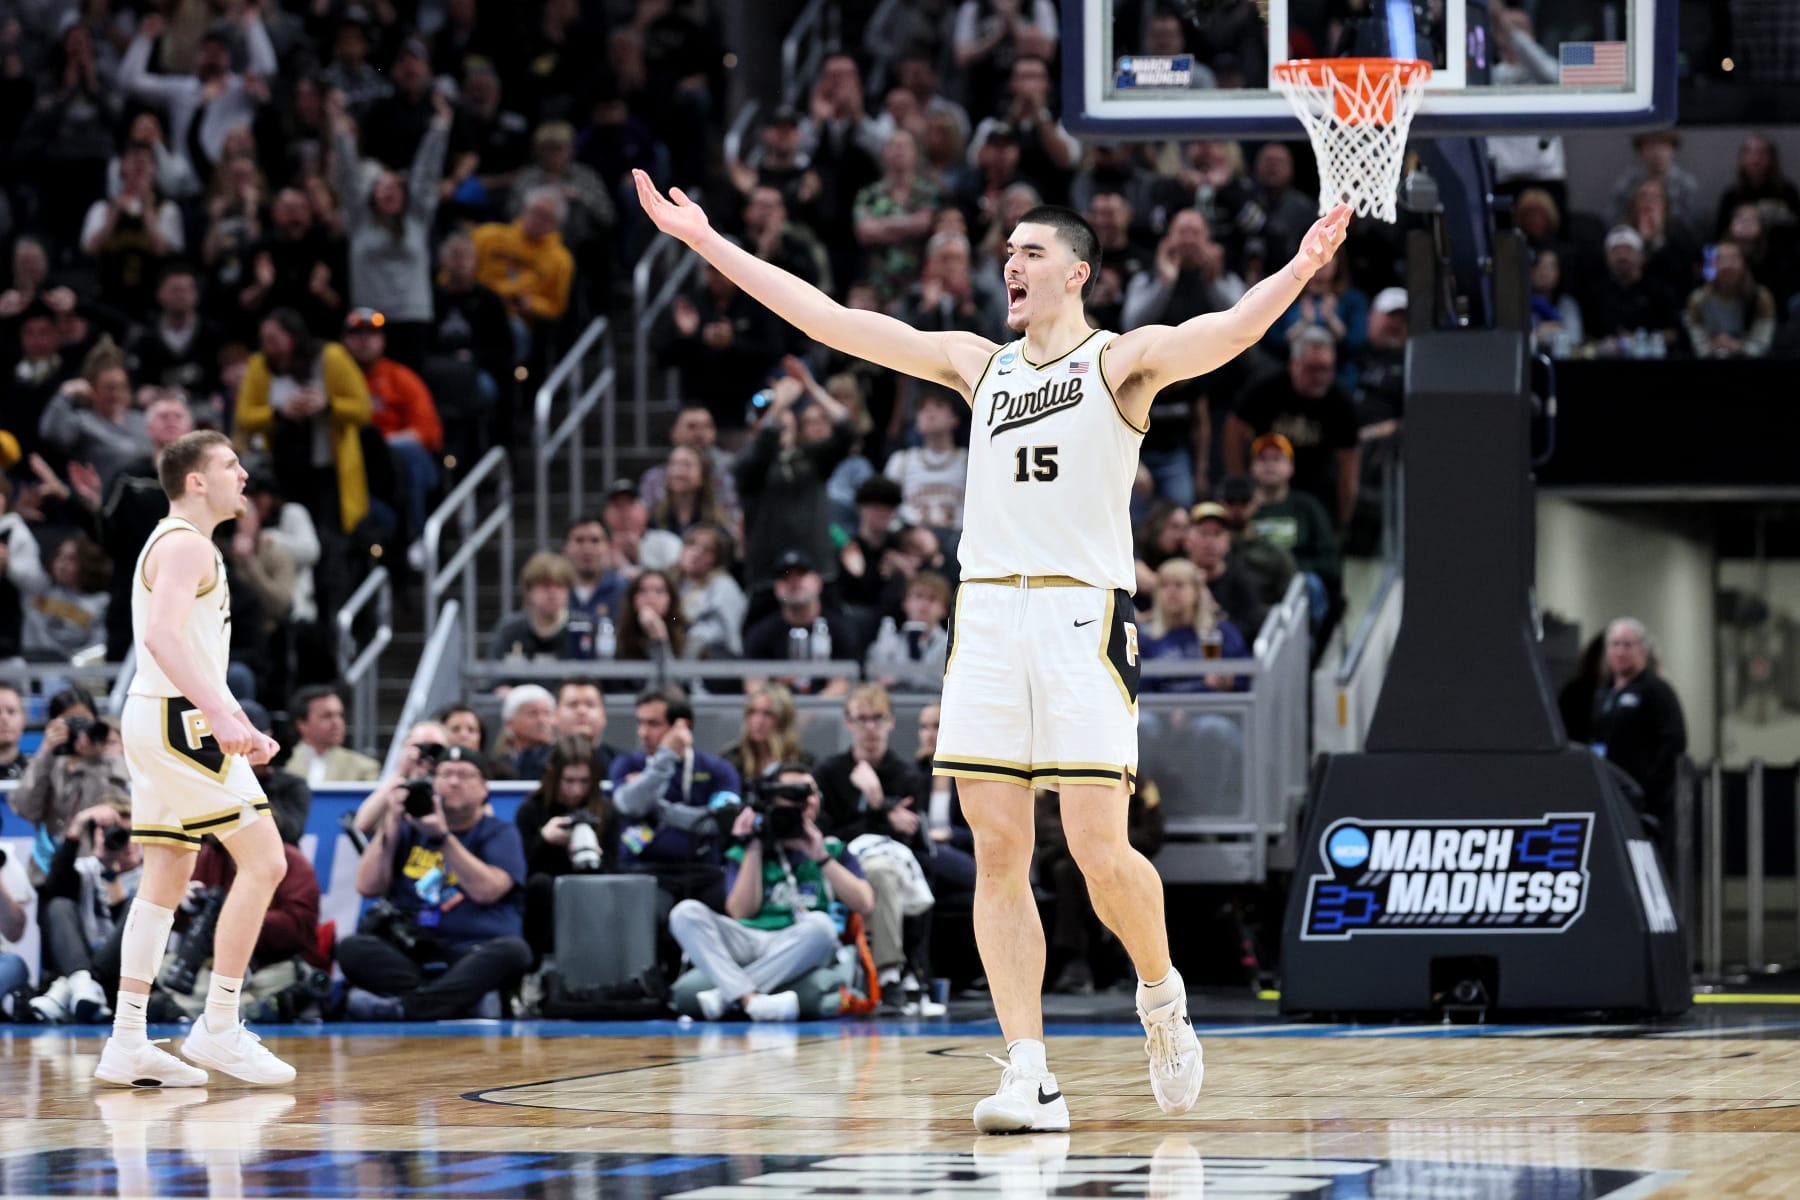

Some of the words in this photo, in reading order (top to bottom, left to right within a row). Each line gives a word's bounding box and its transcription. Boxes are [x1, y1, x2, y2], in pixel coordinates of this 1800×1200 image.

[987, 377, 1084, 440] Purdue
[1014, 444, 1059, 482] 15
[180, 708, 213, 751] P
[1368, 829, 1515, 871] MARCH
[1385, 871, 1583, 914] MADNESS
